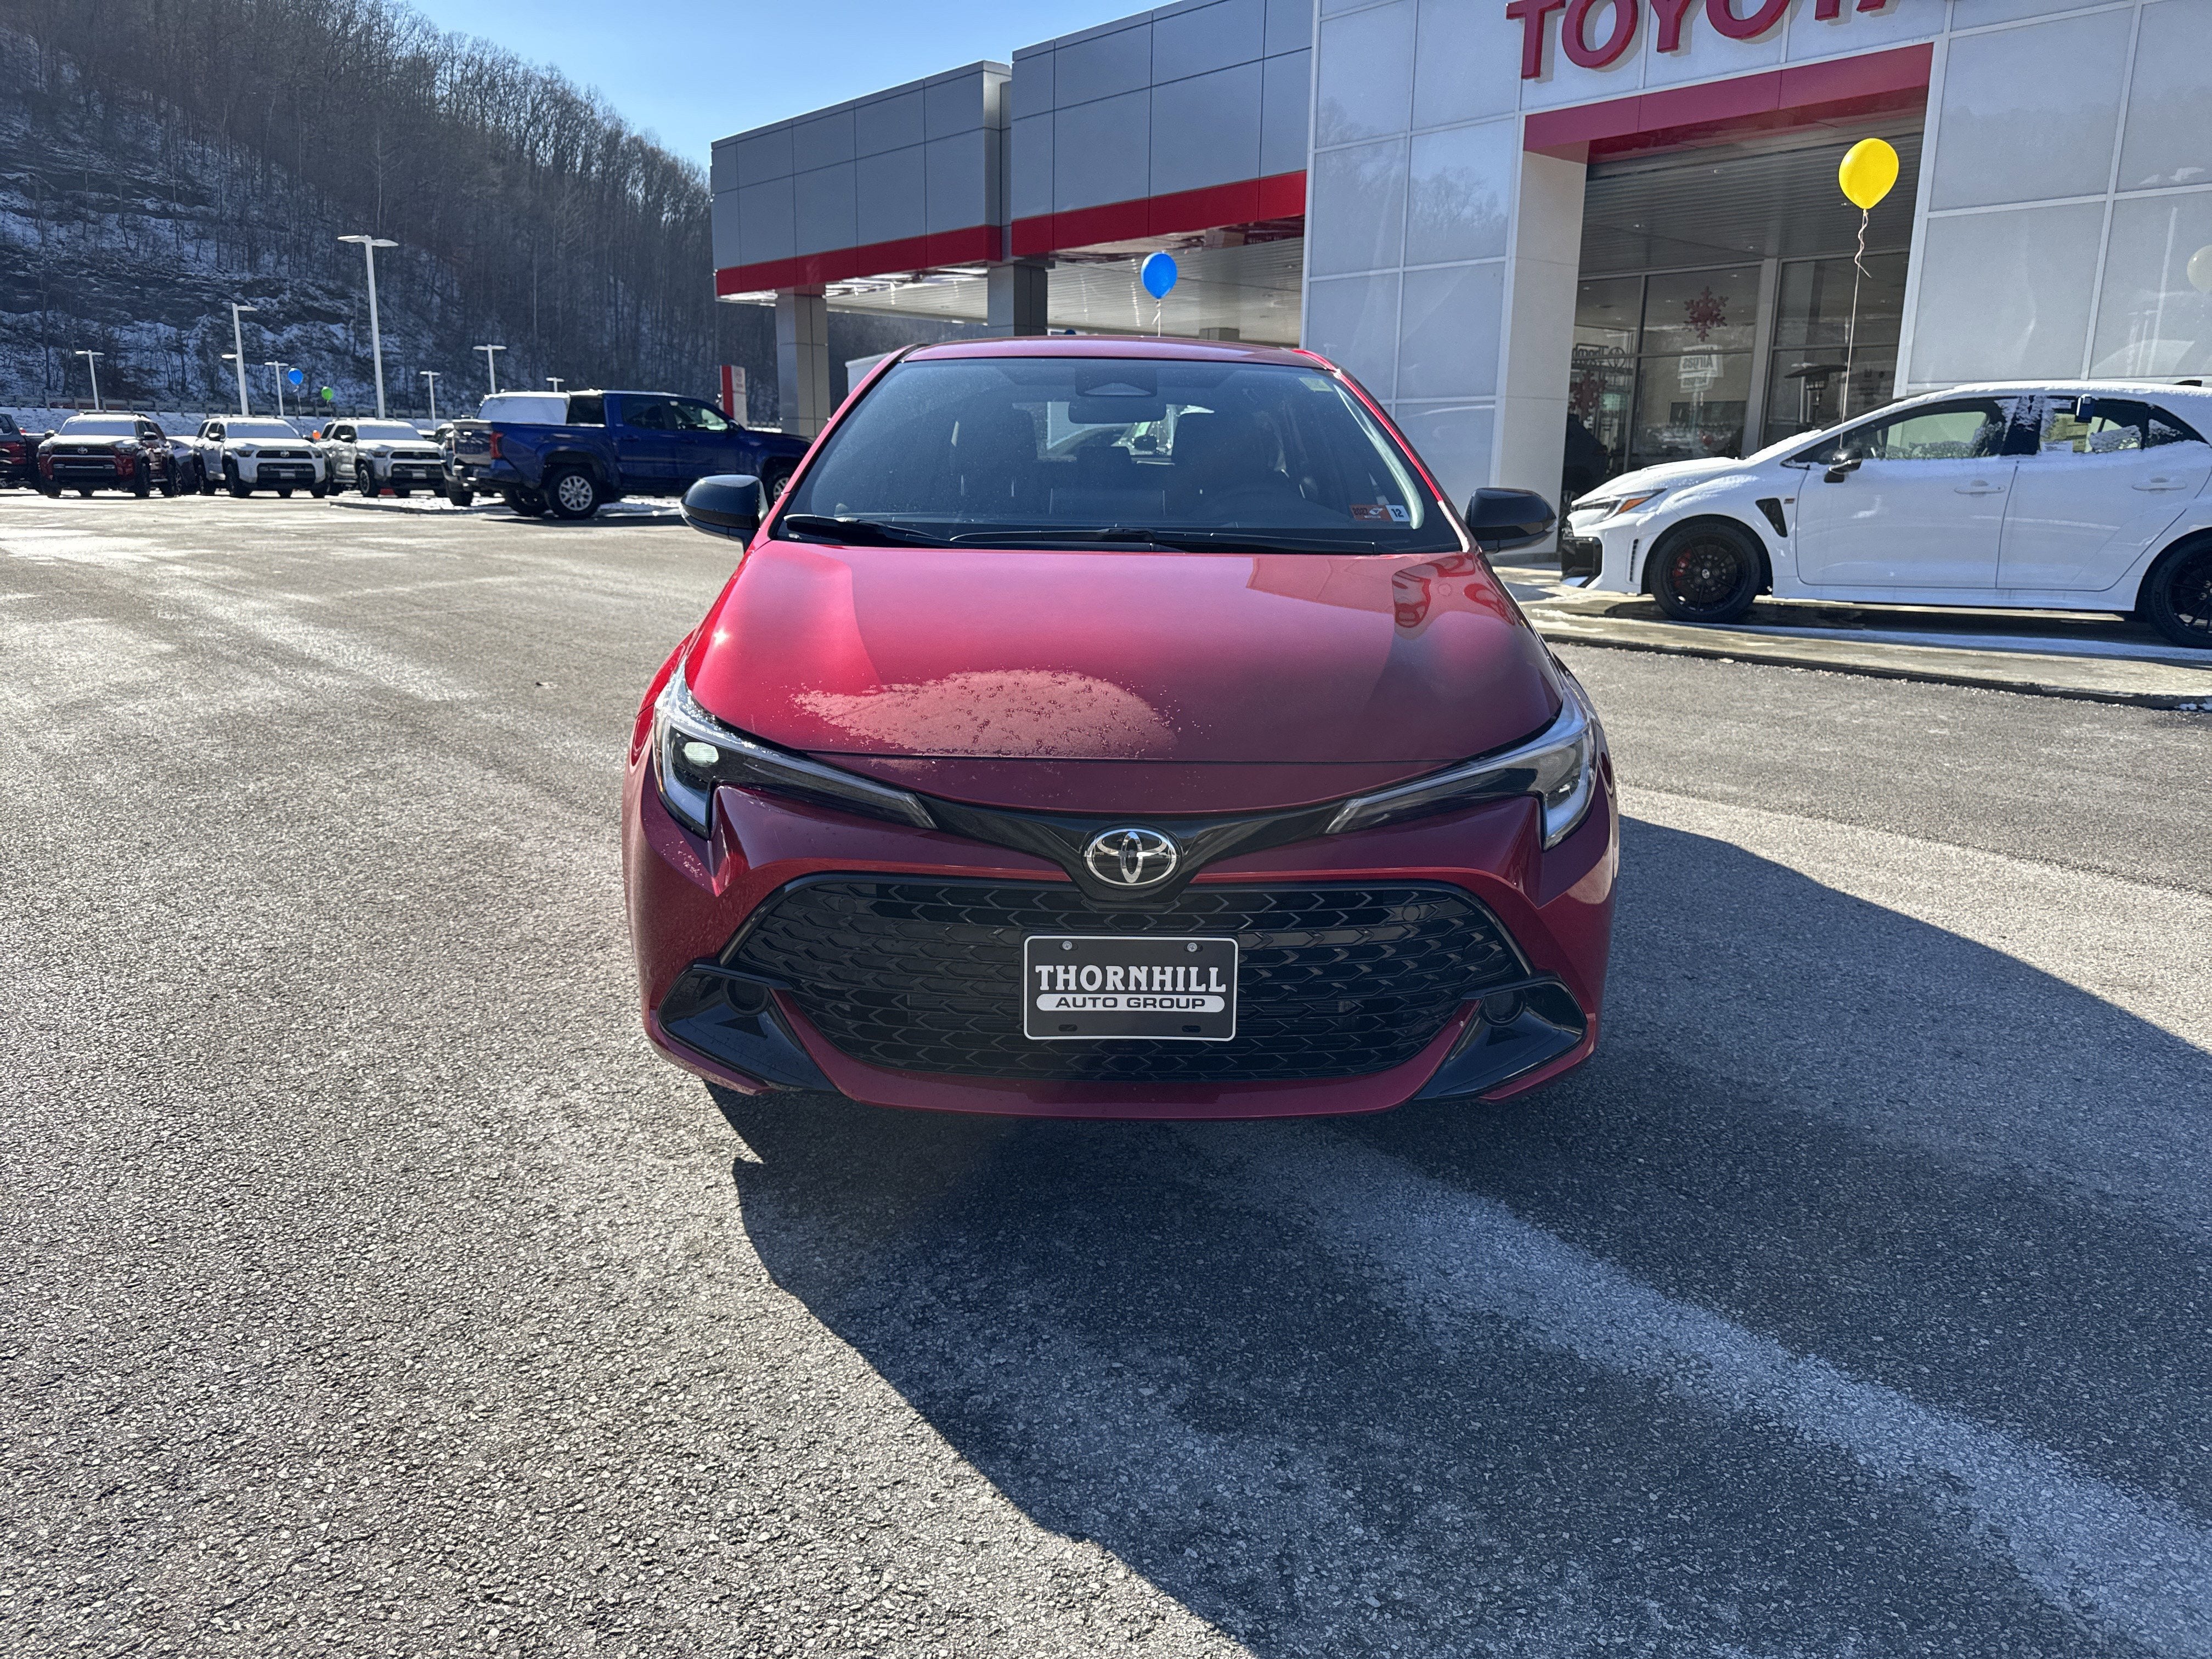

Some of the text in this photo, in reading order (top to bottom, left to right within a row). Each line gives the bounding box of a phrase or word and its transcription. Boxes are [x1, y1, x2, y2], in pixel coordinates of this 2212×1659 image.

[1391, 508, 1404, 518] 12
[1035, 964, 1226, 992] THORNHILL
[1055, 997, 1206, 1009] AUTO GROUP
